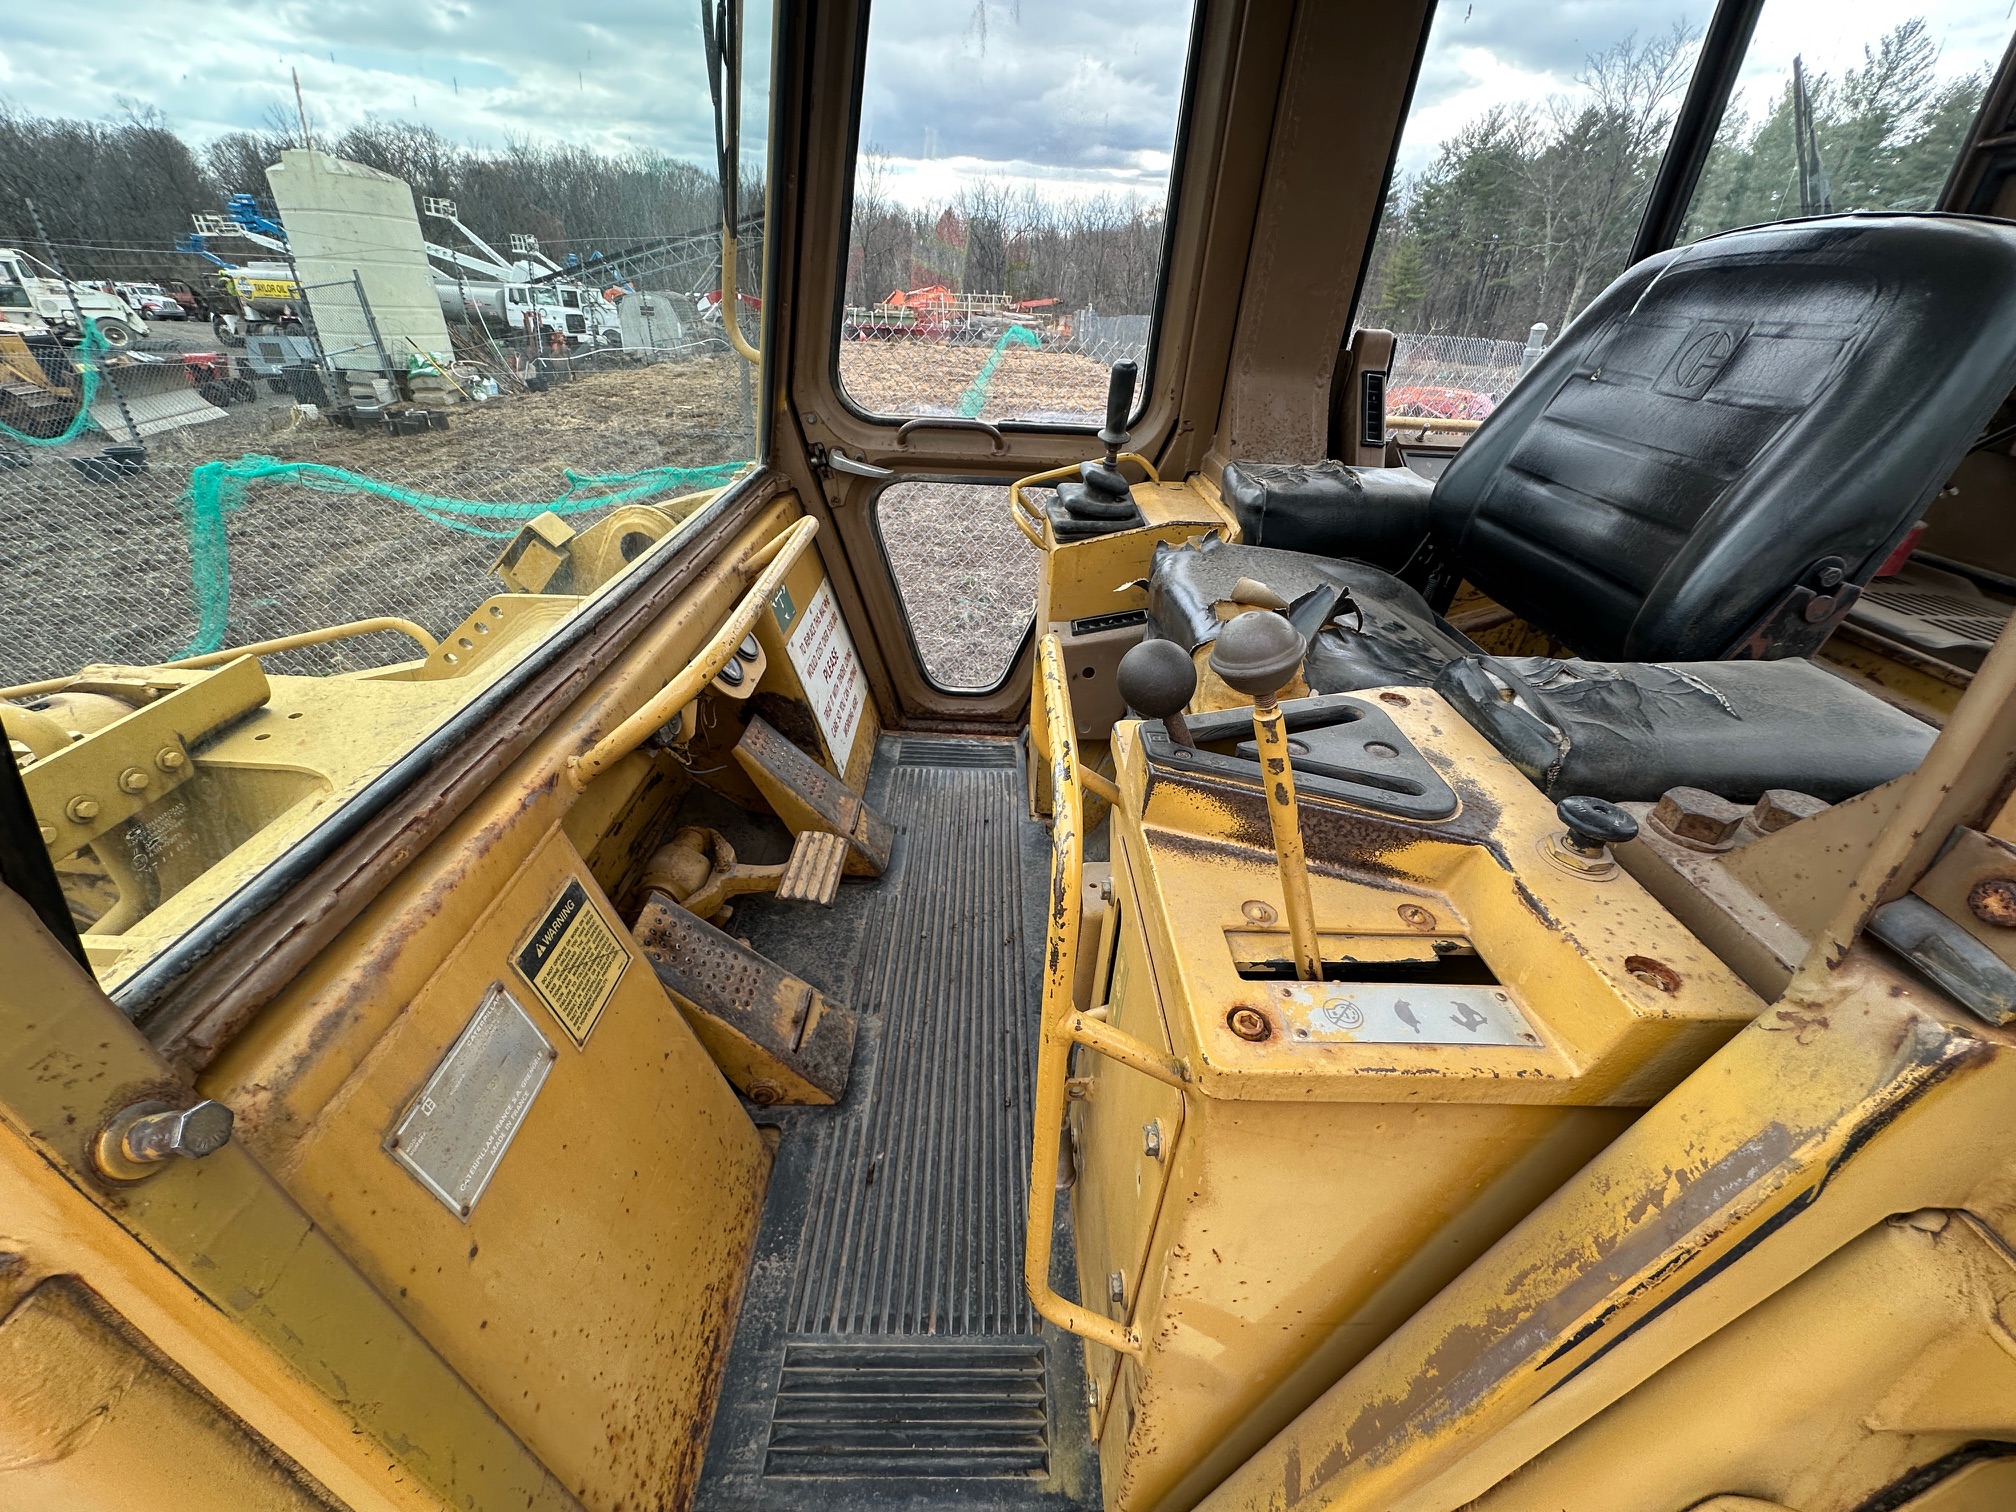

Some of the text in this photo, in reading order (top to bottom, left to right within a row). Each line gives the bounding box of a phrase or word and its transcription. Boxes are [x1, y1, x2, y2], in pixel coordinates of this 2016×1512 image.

[254, 284, 276, 293] TAYLOR
[276, 285, 287, 294] OIL
[798, 640, 806, 657] TO
[803, 621, 816, 649] REPLACE
[812, 610, 821, 630] THIS
[805, 652, 818, 681] WOULD
[814, 639, 824, 661] COST
[820, 627, 829, 649] OVER
[822, 644, 839, 685] PLEASE
[836, 662, 846, 687] TENDER
[823, 699, 832, 722] TREAT
[829, 693, 834, 707] IT
[831, 679, 839, 701] WITH
[838, 695, 846, 715] YOU
[842, 684, 850, 703] CAN
[830, 716, 839, 740] CARE
[835, 707, 842, 724] SO
[842, 705, 854, 740] WORKING
[541, 897, 575, 946] WARNING
[540, 908, 590, 985] DO NOT OPERATE OR WORK ON THIS
[544, 913, 594, 990] MACHINE UNLESS YOU HAVE READ
[548, 981, 556, 994] AND
[556, 949, 577, 981] UNDERSTAND
[551, 983, 562, 999] TIONS
[560, 973, 568, 985] AND
[555, 990, 564, 1004] TION
[564, 977, 572, 990] AND
[558, 988, 572, 1009] FAILURE
[571, 979, 577, 988] TO
[575, 960, 588, 980] FOLLOW
[562, 997, 572, 1013] TIONS
[570, 990, 576, 1000] OR
[574, 978, 583, 993] HEED
[599, 935, 609, 951] COULD
[565, 998, 577, 1018] RESULT
[576, 991, 581, 999] IN
[580, 975, 591, 993] INJURY
[590, 967, 596, 976] OR
[569, 1008, 577, 1022] TACT
[582, 969, 601, 1000] CATERPILLAR
[599, 954, 610, 972] DEALER
[572, 993, 593, 1027] REPLACEMENT
[601, 960, 612, 978] PROPER
[465, 993, 500, 1047] CATERPILLAR
[579, 1011, 588, 1026] YOUR
[459, 1133, 495, 1192] CATERPILLAR
[492, 1102, 513, 1135] FRANCE
[519, 1049, 543, 1089] GRENOBLE
[489, 1130, 506, 1156] MADE
[503, 1118, 513, 1132] IN
[509, 1088, 529, 1121] FRANCE
